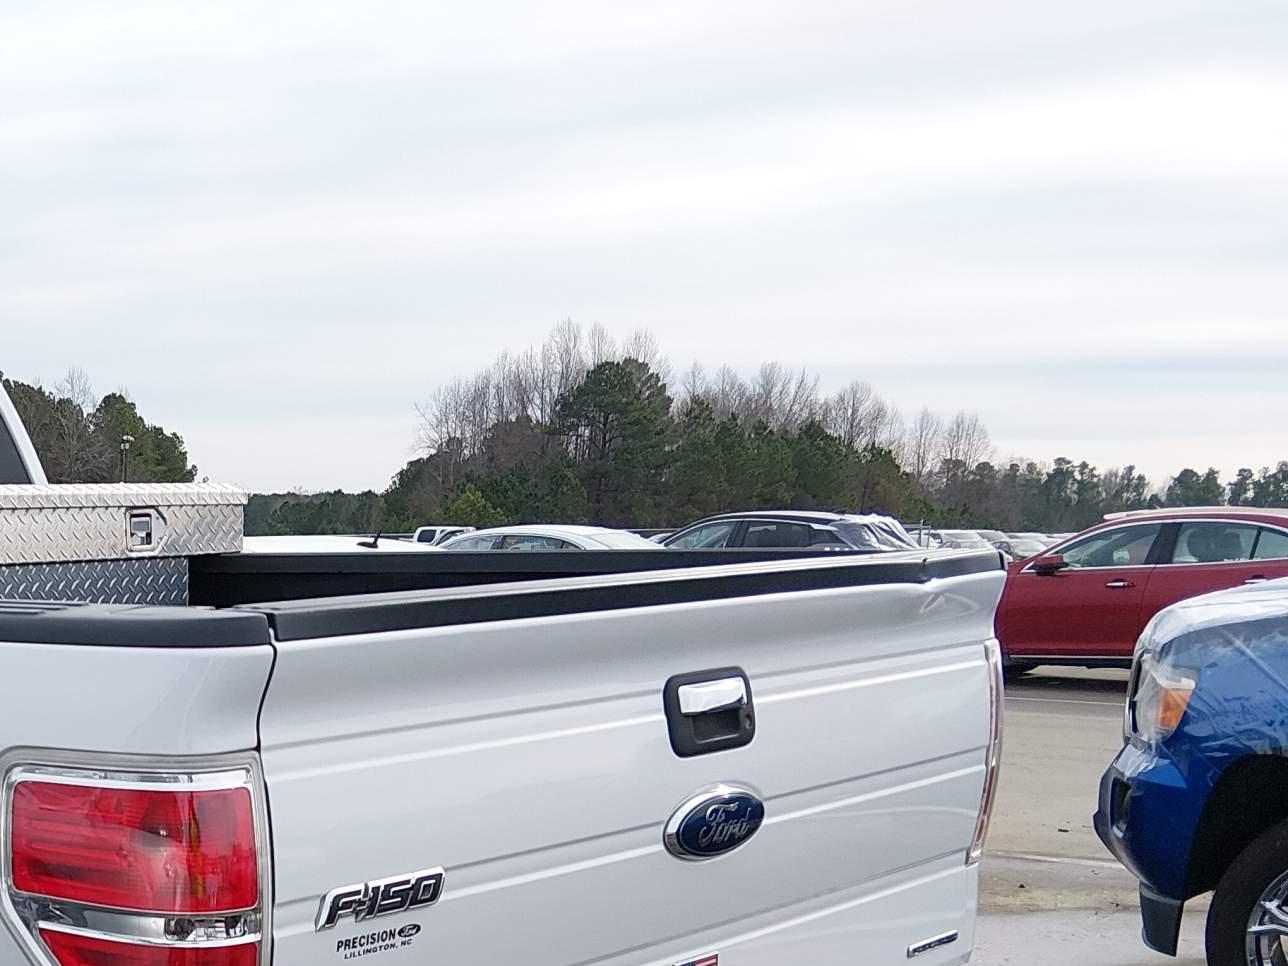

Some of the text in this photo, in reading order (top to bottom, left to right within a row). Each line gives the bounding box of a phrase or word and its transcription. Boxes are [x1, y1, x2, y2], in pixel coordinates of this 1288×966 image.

[697, 801, 752, 848] Ford
[315, 866, 445, 932] F-150
[336, 928, 397, 952] PRECISION
[344, 938, 413, 960] LILLINGTON, NC
